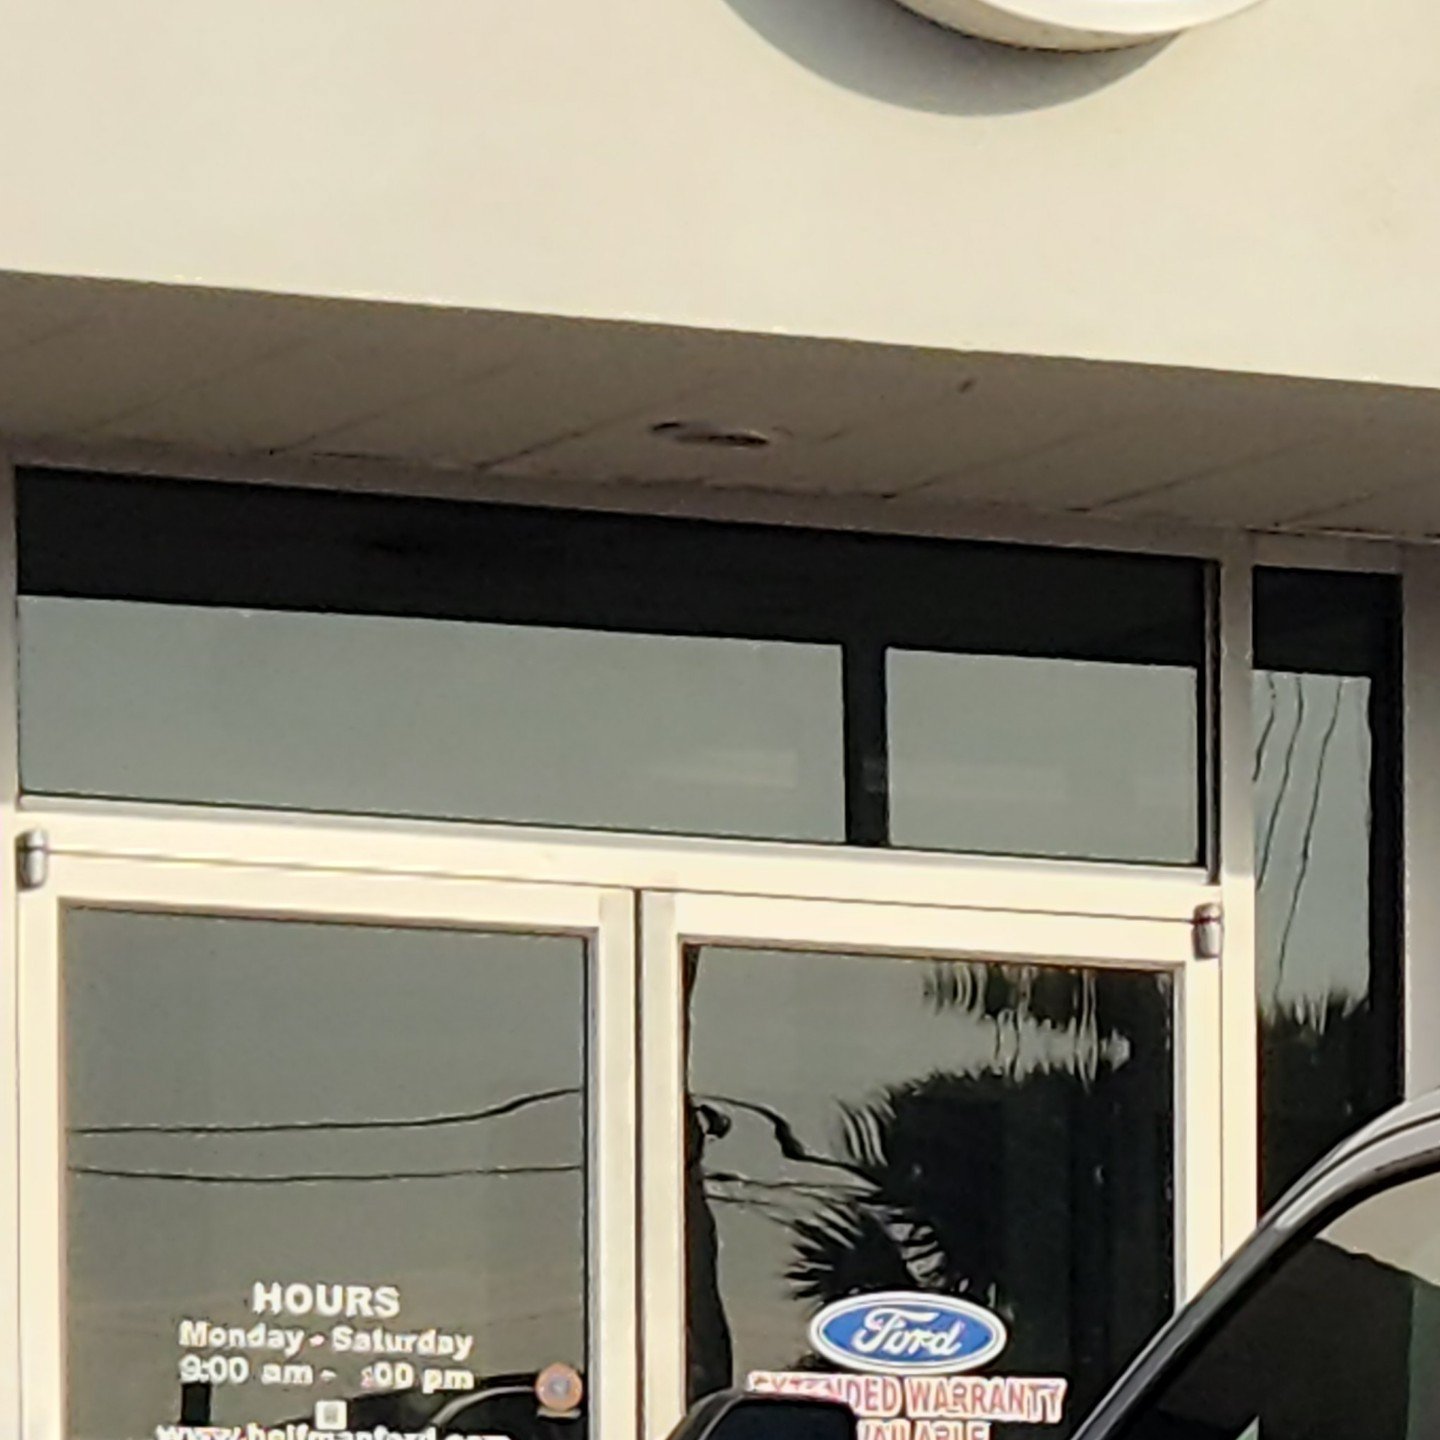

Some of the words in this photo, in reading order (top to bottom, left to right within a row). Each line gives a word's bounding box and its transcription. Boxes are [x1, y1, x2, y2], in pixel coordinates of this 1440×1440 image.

[252, 1281, 401, 1318] HOURS
[178, 1319, 305, 1358] Monday
[331, 1325, 473, 1361] Saturday
[852, 1305, 965, 1359] Ford
[179, 1353, 250, 1384] 9:00
[260, 1363, 314, 1385] am
[421, 1368, 475, 1394] pm
[908, 1377, 1062, 1419] WARRANTY
